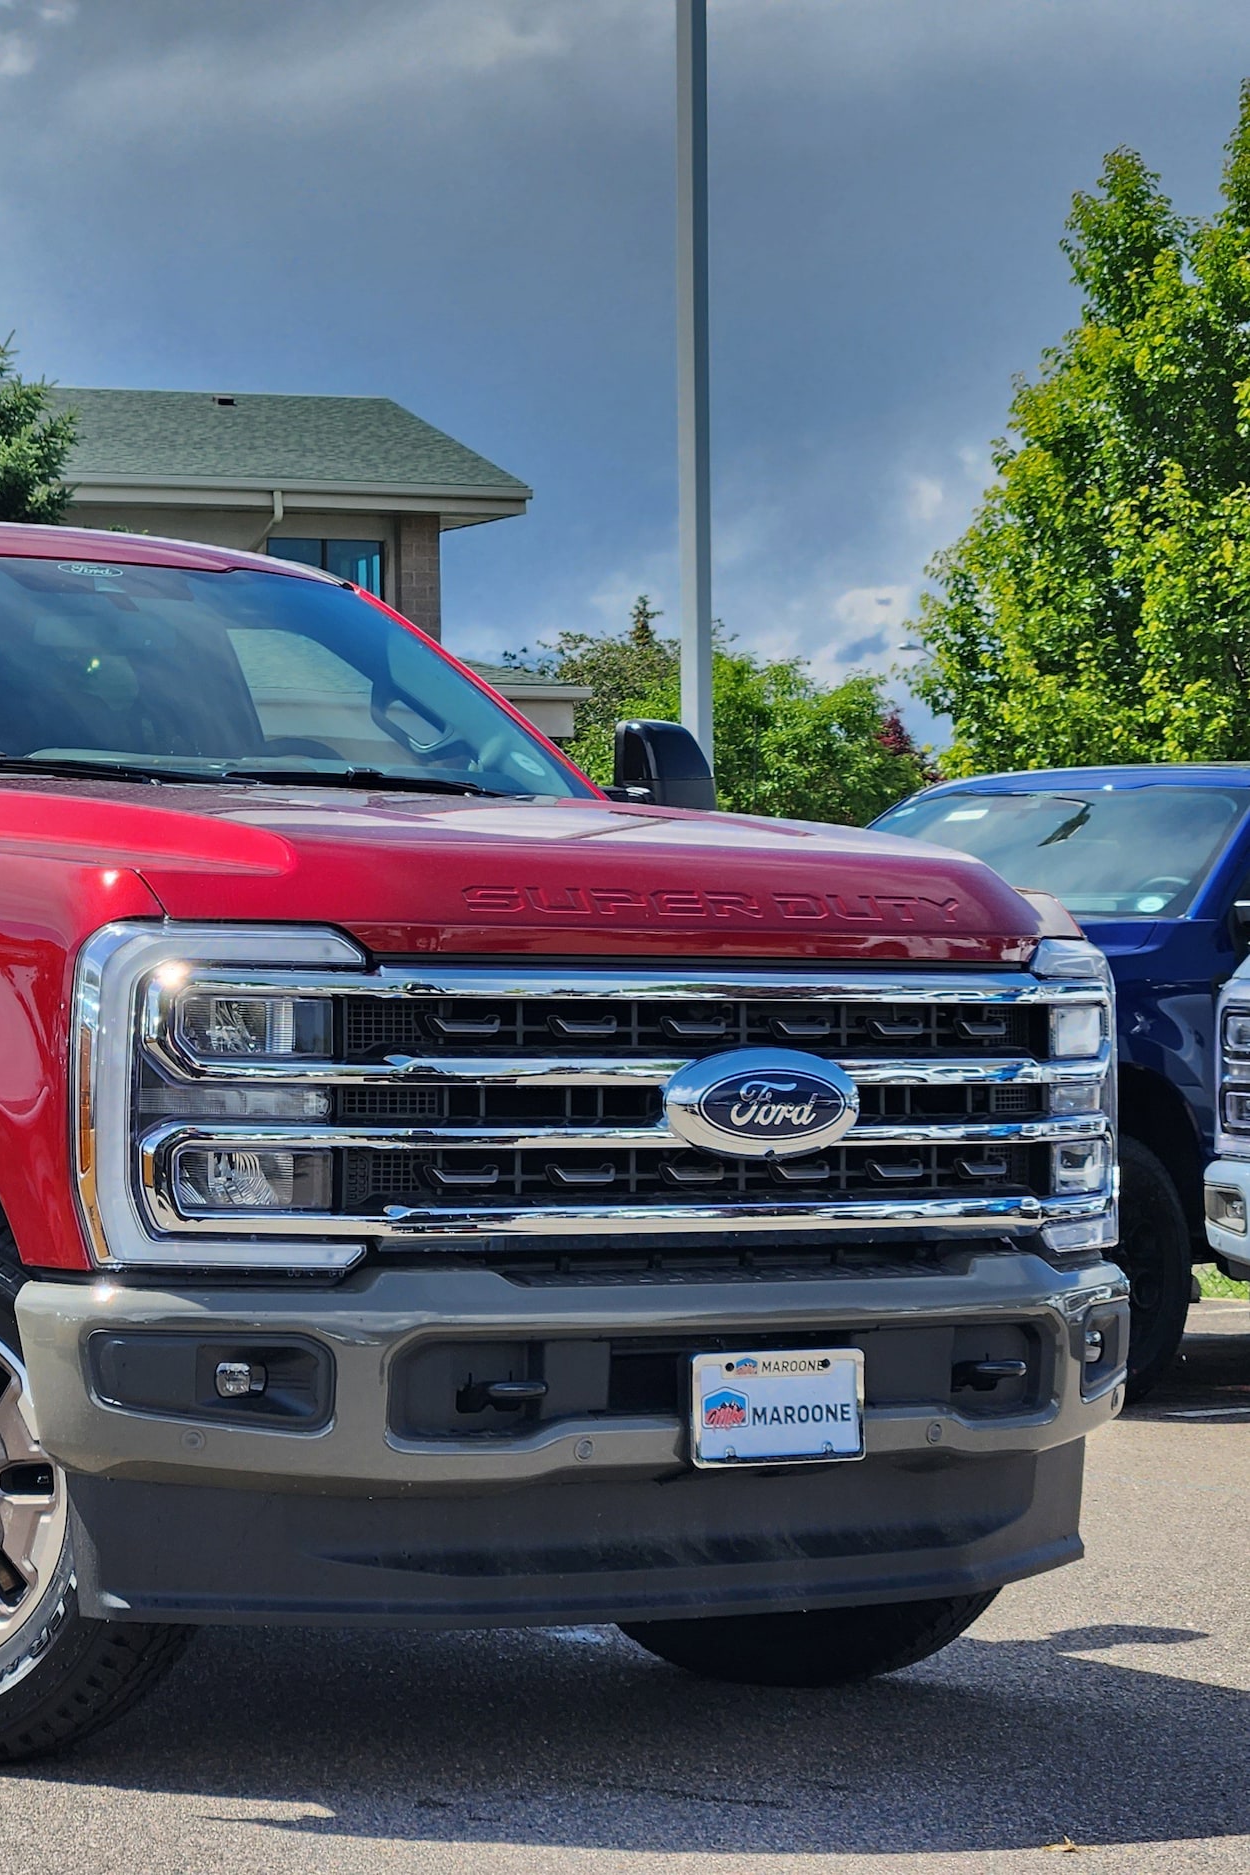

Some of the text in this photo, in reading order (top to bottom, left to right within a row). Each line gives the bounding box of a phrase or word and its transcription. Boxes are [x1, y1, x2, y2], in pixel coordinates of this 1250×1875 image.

[461, 886, 960, 924] SUPER DUTY
[730, 1080, 818, 1126] Ford
[761, 1360, 825, 1373] MAROONE
[752, 1404, 851, 1426] MAROONE
